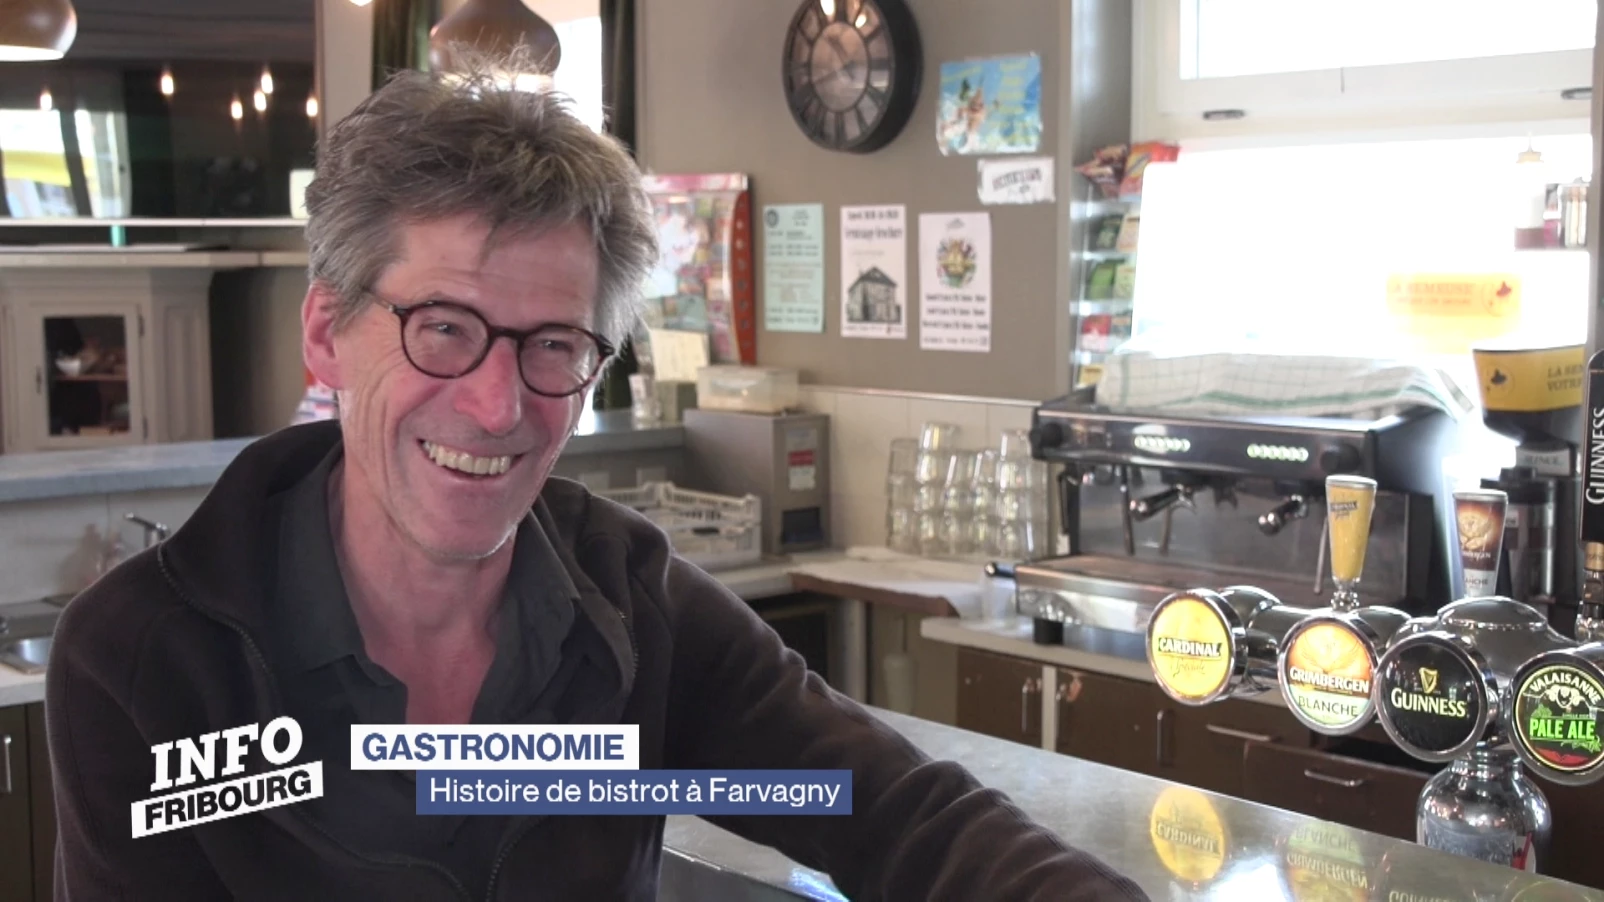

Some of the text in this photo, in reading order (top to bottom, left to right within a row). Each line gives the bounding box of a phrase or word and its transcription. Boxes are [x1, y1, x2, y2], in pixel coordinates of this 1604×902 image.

[1547, 366, 1562, 378] LA
[1158, 637, 1220, 657] CARDINAL
[1289, 666, 1369, 693] GRIMBERGEN
[1530, 672, 1602, 705] VALAISANNE
[1299, 695, 1359, 717] BLANCHE
[1391, 687, 1466, 718] GUINNESS
[1529, 718, 1596, 740] PALE ALE
